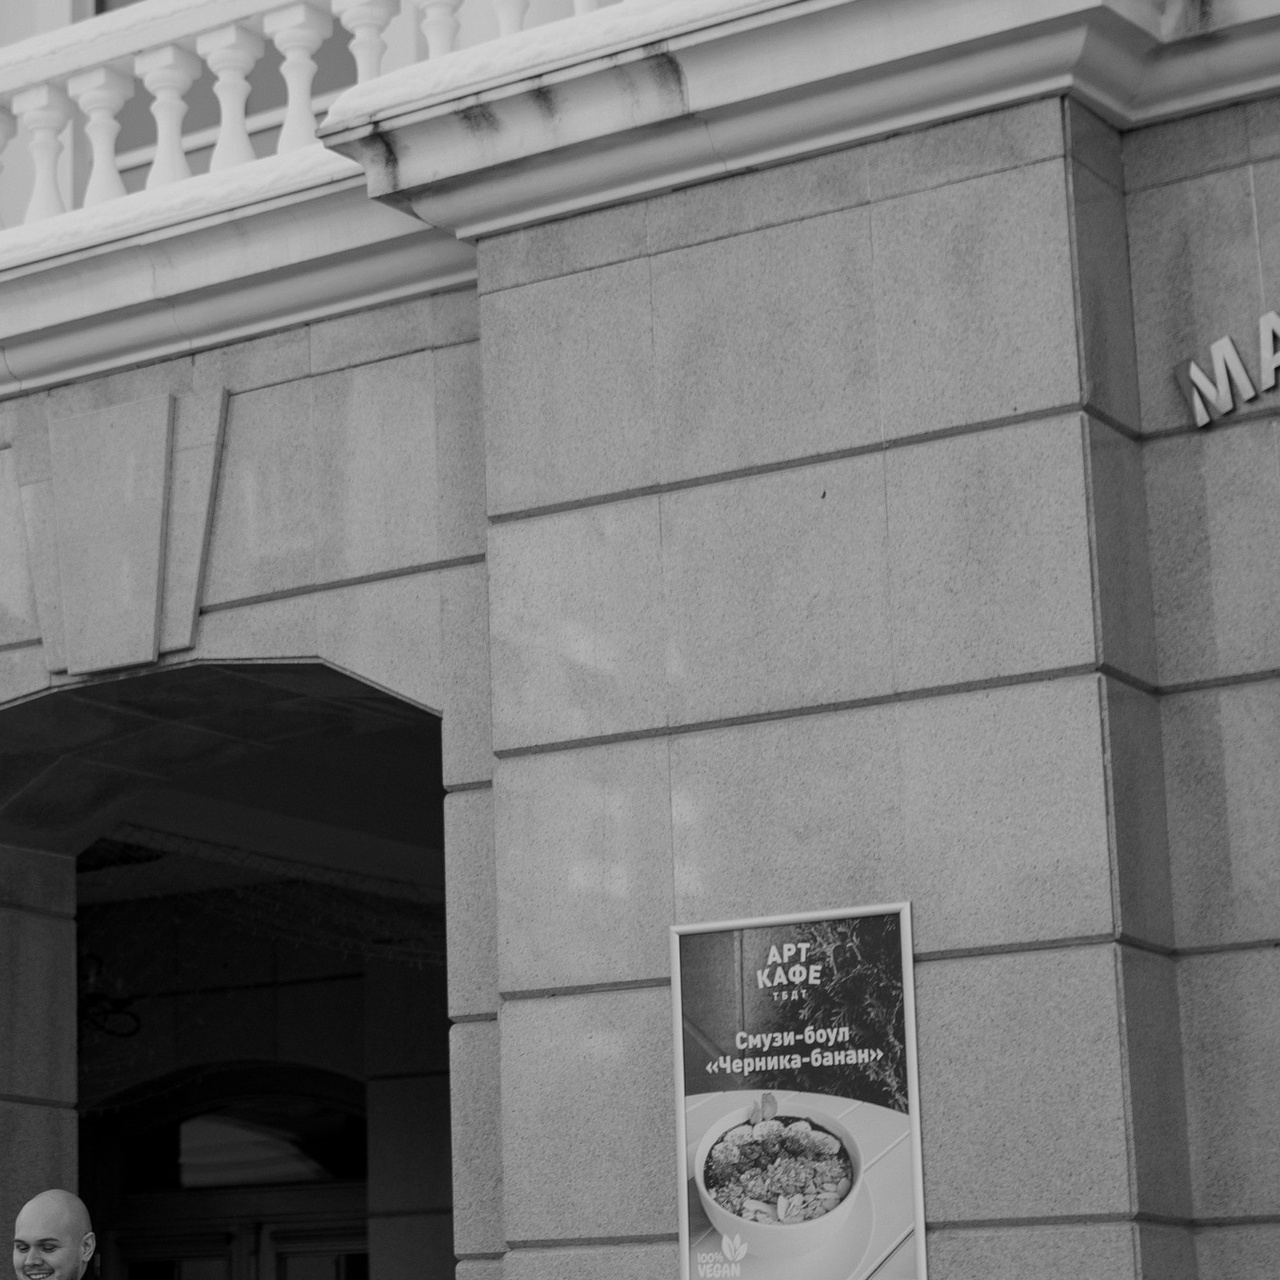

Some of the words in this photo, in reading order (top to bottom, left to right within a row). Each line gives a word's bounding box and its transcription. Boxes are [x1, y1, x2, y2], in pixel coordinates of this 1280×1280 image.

[767, 942, 811, 965] АРТ
[756, 964, 823, 989] КАФЕ
[772, 989, 808, 1001] ТБДТ
[735, 1025, 850, 1052] Смузи-боул
[705, 1047, 885, 1077] «Черника-банан»
[696, 1251, 724, 1263] 100%
[697, 1262, 741, 1278] VEGAN
